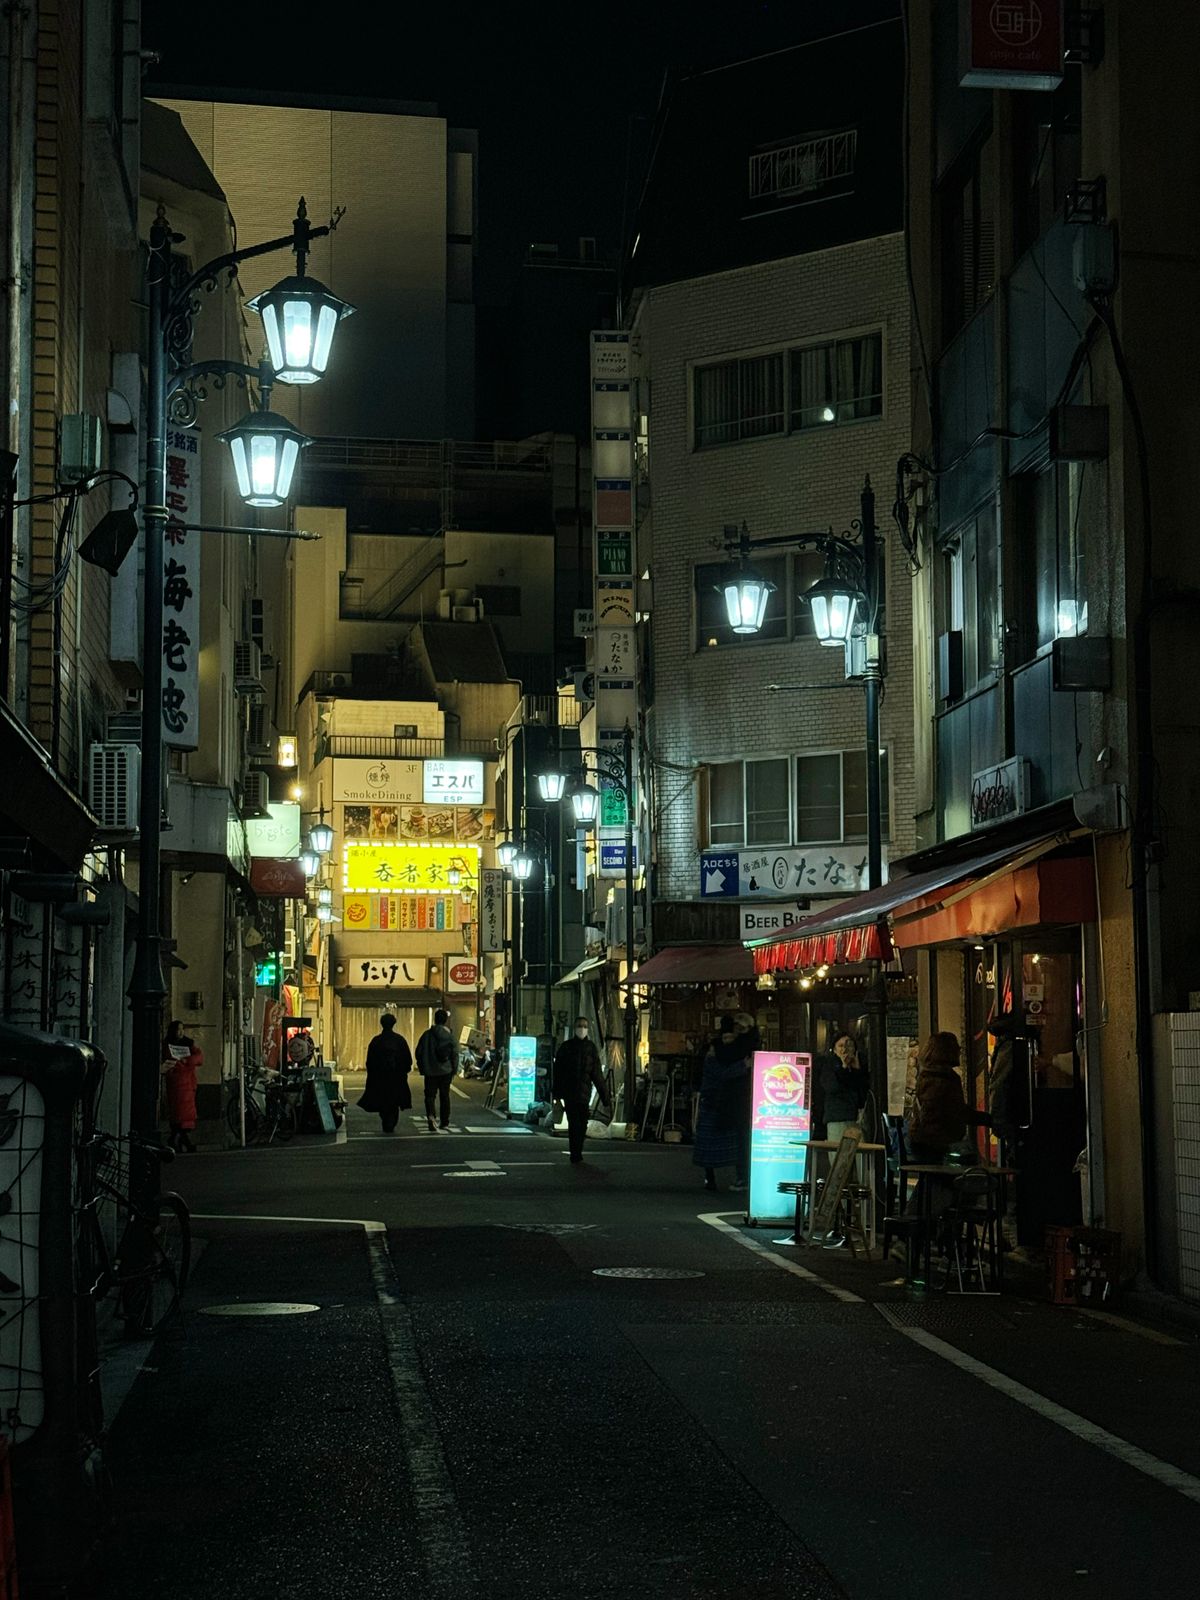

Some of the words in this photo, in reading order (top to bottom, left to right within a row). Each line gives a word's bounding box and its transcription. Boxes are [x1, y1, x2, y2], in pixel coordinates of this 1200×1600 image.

[405, 764, 417, 773] 3F
[426, 763, 445, 772] BAR
[431, 774, 475, 788] エスパ
[443, 795, 463, 803] ESP
[743, 856, 770, 873] 居酒屋
[745, 914, 779, 929] BEER
[361, 961, 415, 984] たけし
